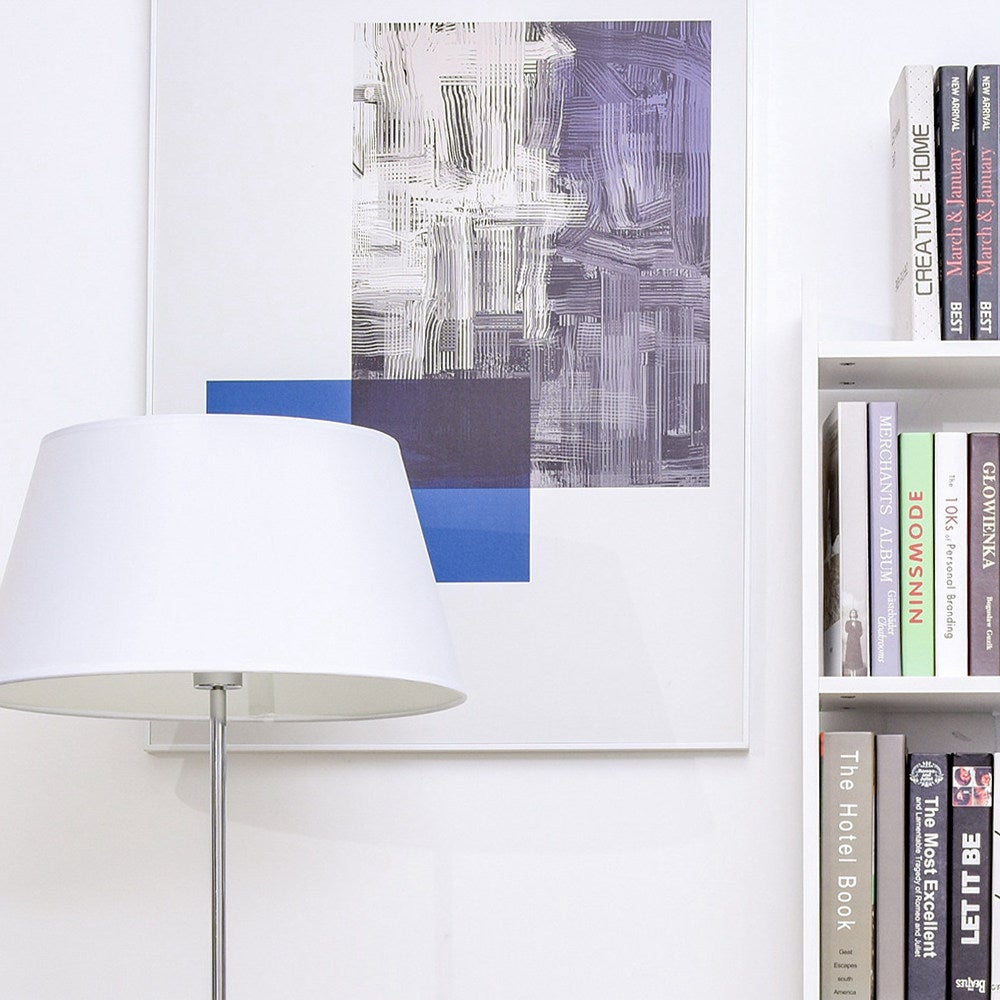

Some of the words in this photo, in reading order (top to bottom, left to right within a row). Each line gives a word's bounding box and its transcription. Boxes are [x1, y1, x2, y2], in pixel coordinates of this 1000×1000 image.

[951, 76, 960, 98] NEW
[982, 76, 990, 97] NEW
[951, 99, 961, 132] ARRIVAL
[982, 98, 991, 131] ARRIVAL
[913, 124, 930, 182] HOME
[949, 147, 965, 208] January
[979, 147, 996, 208] January
[948, 212, 962, 225] &
[978, 212, 992, 225] &
[915, 193, 933, 296] CREATIVE
[947, 228, 963, 276] March
[977, 228, 993, 276] March
[951, 302, 962, 334] BEST
[980, 302, 992, 334] BEST
[879, 415, 892, 515] MERCHANTS
[945, 497, 958, 532] 10Ks
[880, 527, 892, 583] ALBUM
[909, 491, 924, 624] NINSMODE
[946, 544, 956, 590] Personal
[944, 595, 955, 640] Branding
[876, 616, 887, 663] Cloakrooms
[840, 751, 859, 790] The
[838, 803, 858, 863] Hotel
[923, 797, 939, 828] The
[914, 854, 922, 882] Tragedy
[923, 833, 939, 875] Most
[962, 833, 980, 865] BE
[836, 876, 857, 930] Book
[962, 871, 980, 894] IT
[923, 880, 938, 958] Excellent
[961, 901, 980, 944] LET
